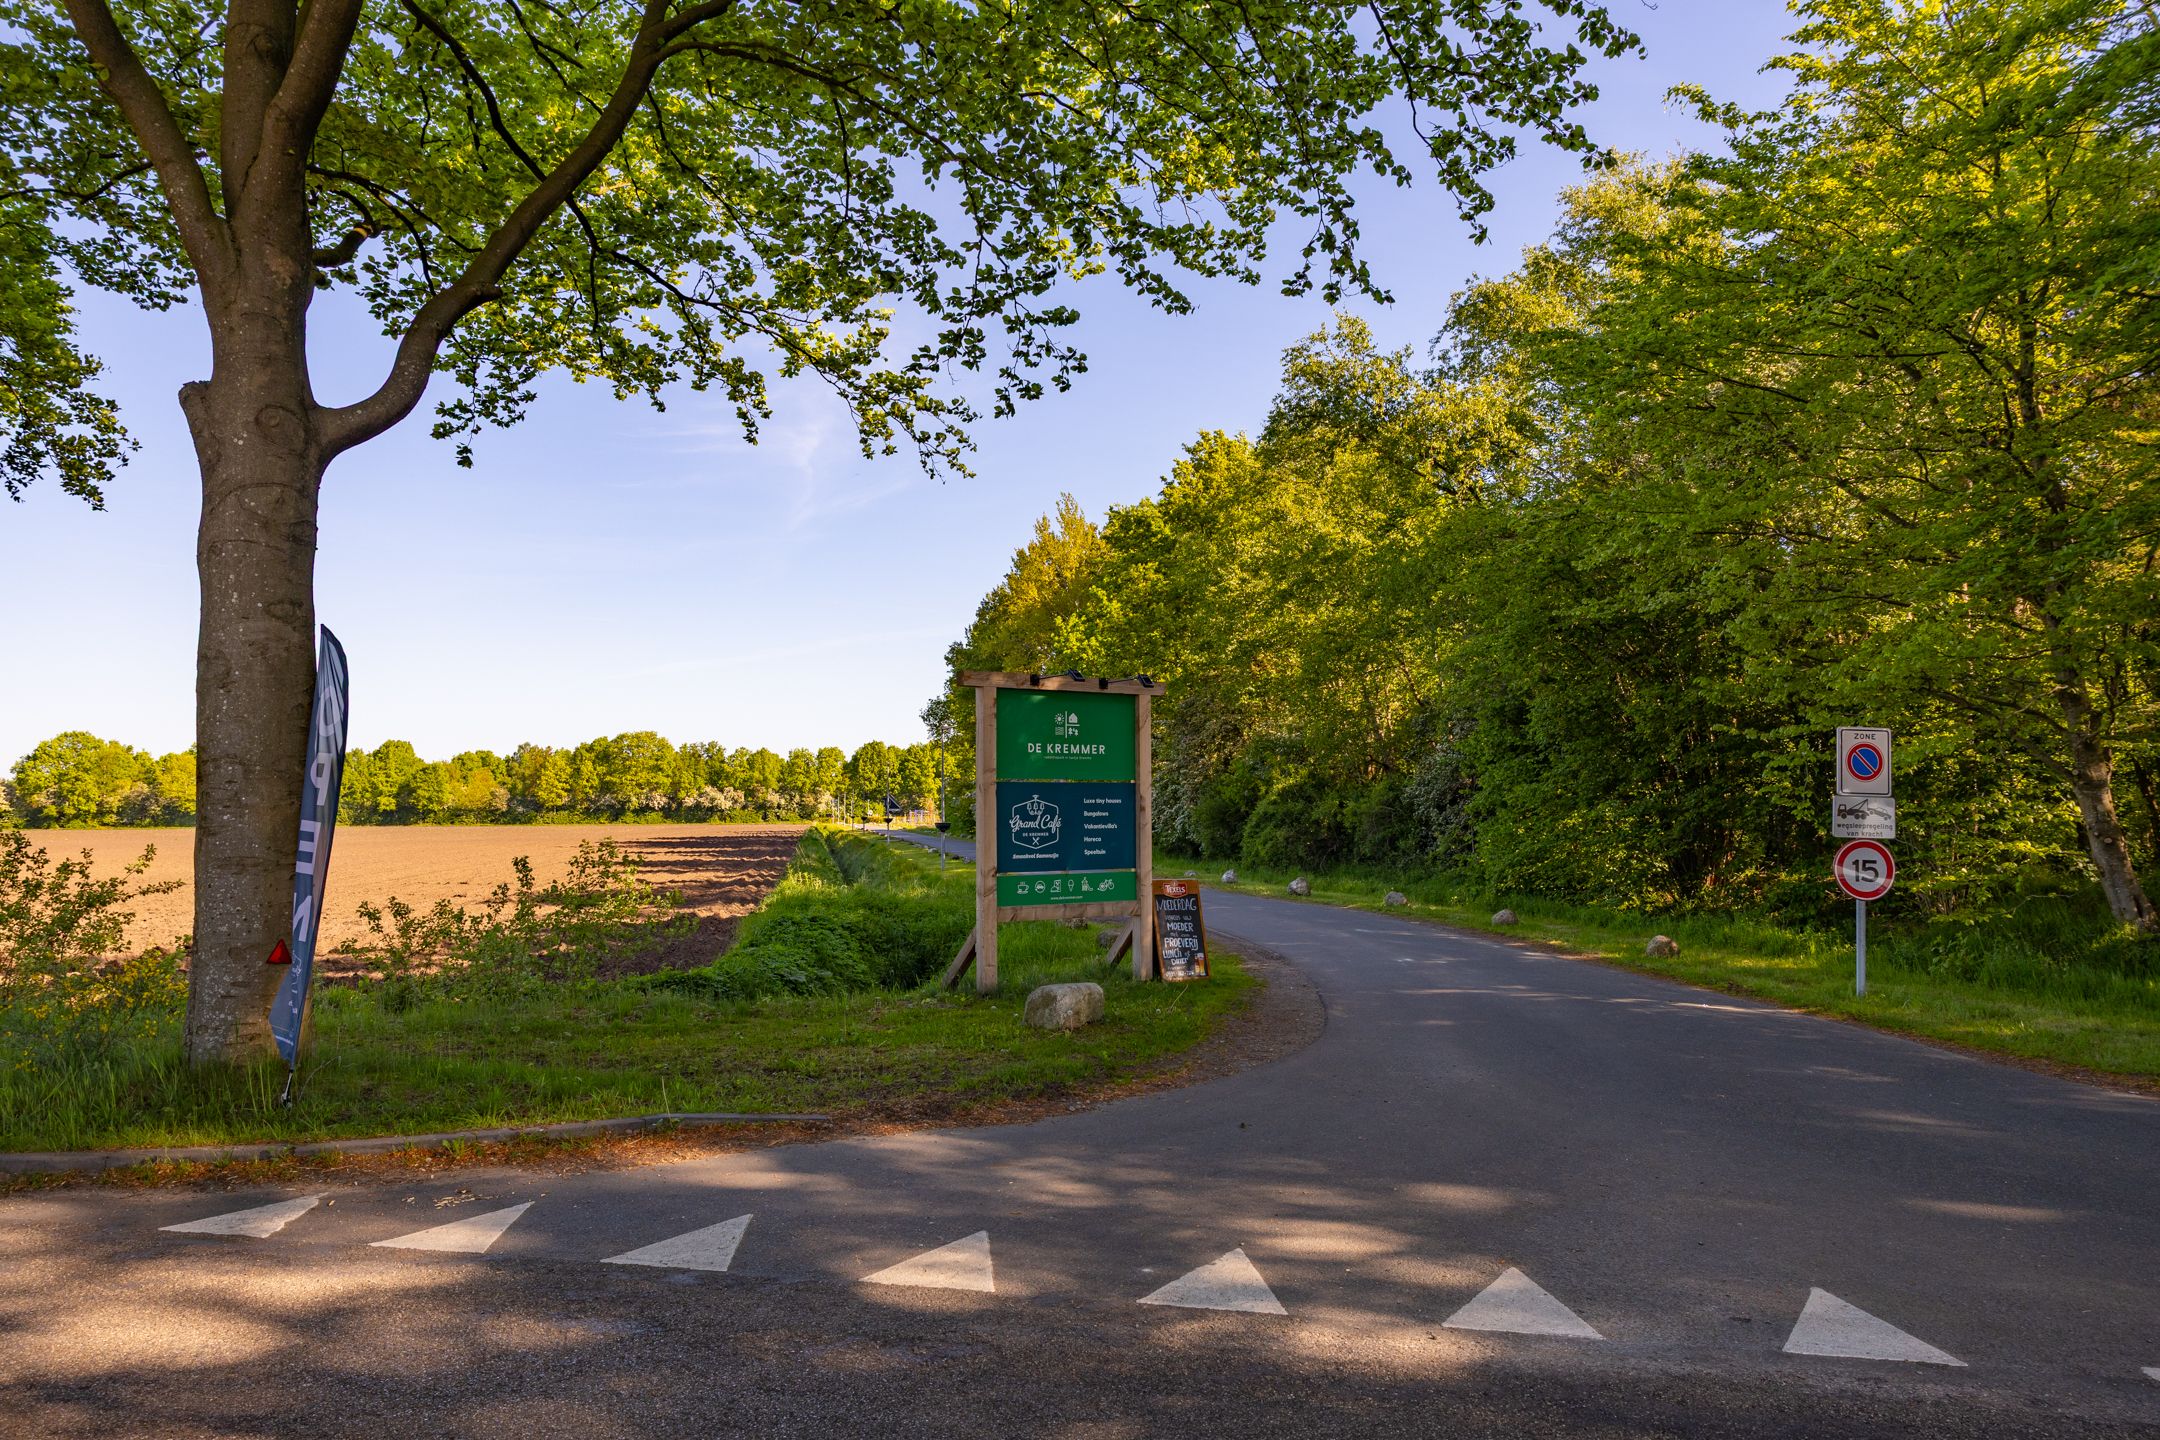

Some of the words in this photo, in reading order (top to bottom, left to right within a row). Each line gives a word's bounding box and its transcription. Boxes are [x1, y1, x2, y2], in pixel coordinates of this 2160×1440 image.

[1027, 743, 1042, 753] DE
[1047, 743, 1106, 755] KREMMER
[1083, 810, 1109, 818] Bungalows
[1009, 814, 1040, 833] Grand
[1040, 814, 1062, 834] Café
[1836, 822, 1893, 831] wegsleepregeling
[1852, 859, 1879, 883] 15
[1156, 898, 1197, 912] MOEDERDAG
[1167, 923, 1194, 932] MOEDER
